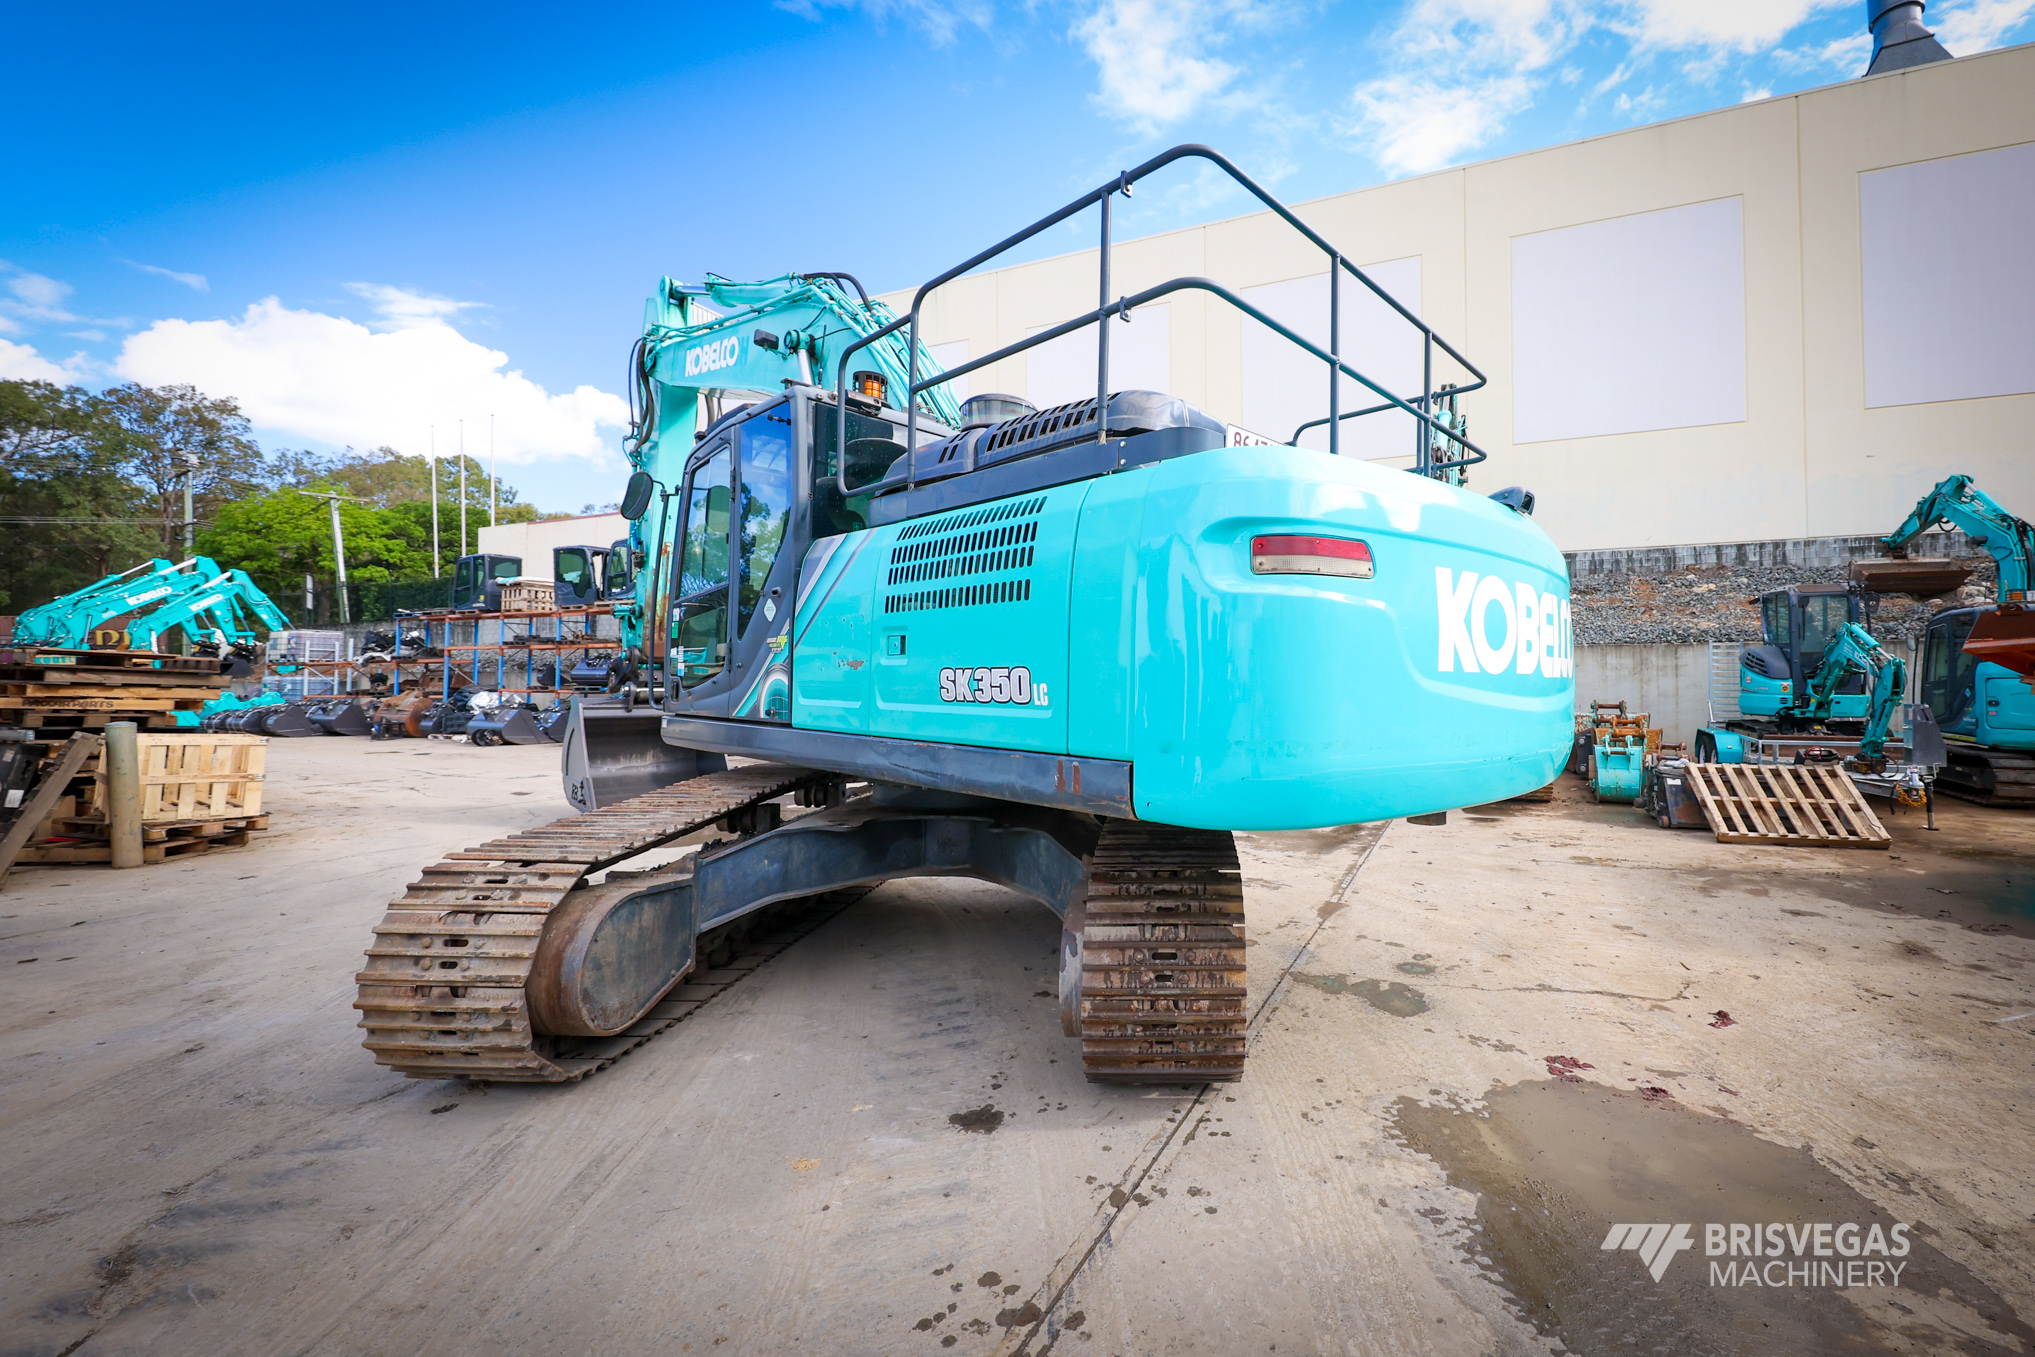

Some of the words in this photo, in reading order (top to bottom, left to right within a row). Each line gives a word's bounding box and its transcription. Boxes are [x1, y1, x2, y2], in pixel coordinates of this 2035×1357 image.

[685, 336, 739, 377] KOBELCO
[939, 666, 1032, 705] SK350
[1032, 683, 1049, 706] LC
